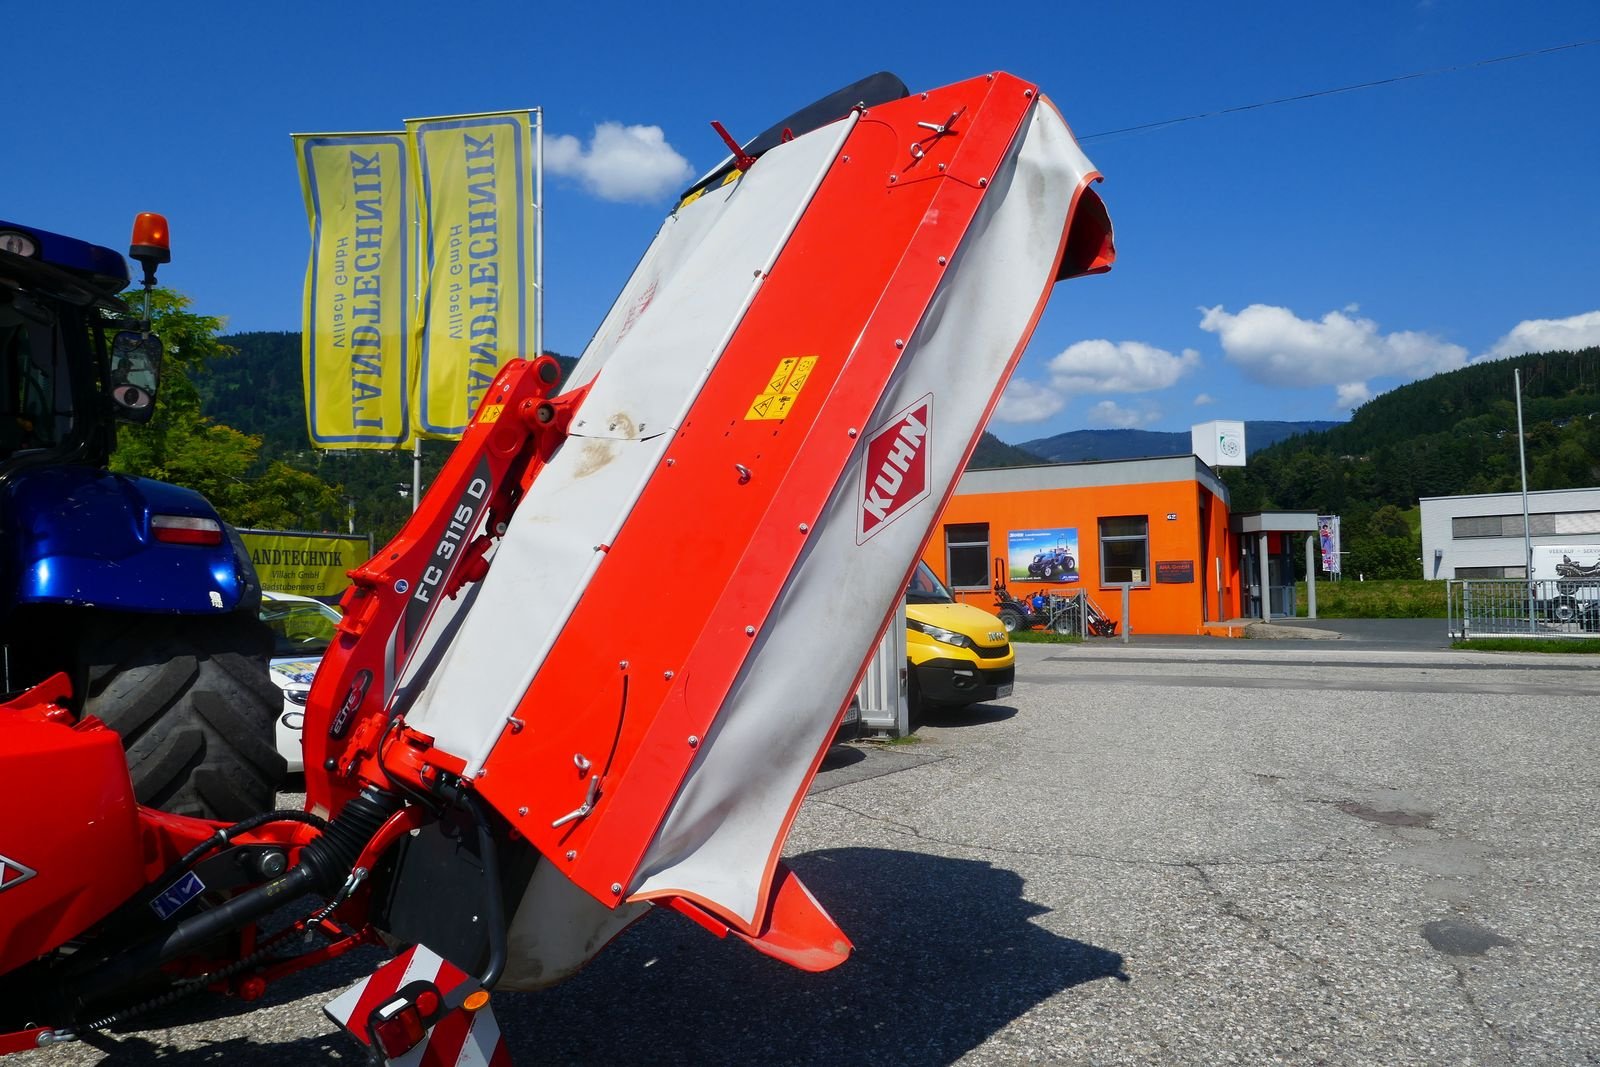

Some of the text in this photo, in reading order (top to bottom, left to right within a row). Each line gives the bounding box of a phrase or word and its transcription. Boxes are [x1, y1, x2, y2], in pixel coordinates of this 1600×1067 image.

[862, 412, 929, 523] KUHN
[414, 478, 487, 603] FC 3115 D
[252, 549, 344, 567] ANDTECHNIK
[261, 582, 326, 592] Badstubenweg 63
[272, 570, 320, 580] Villach GmbH
[334, 692, 356, 734] ELITE
